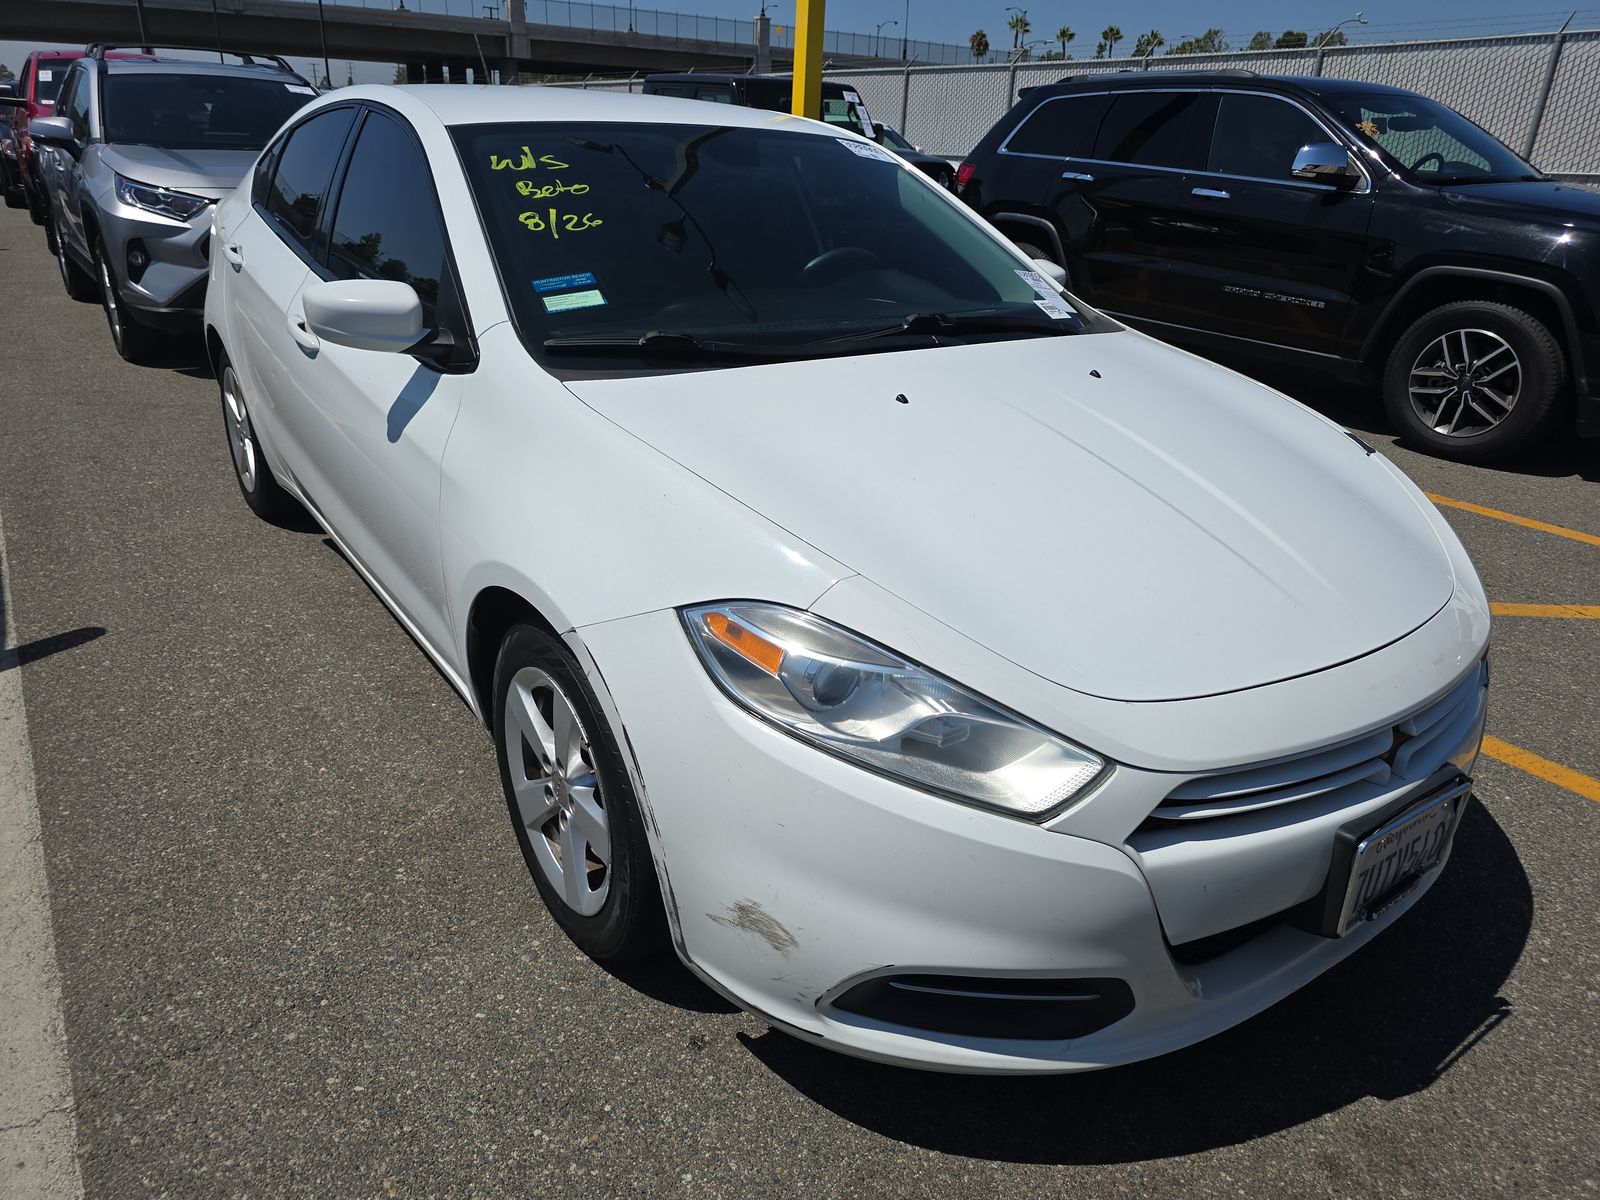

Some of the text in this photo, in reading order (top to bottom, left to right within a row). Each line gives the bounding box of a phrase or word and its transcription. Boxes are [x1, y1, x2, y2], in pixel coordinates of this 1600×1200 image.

[518, 208, 603, 240] 8/26
[532, 272, 592, 285] HUNTINGTON BEACH
